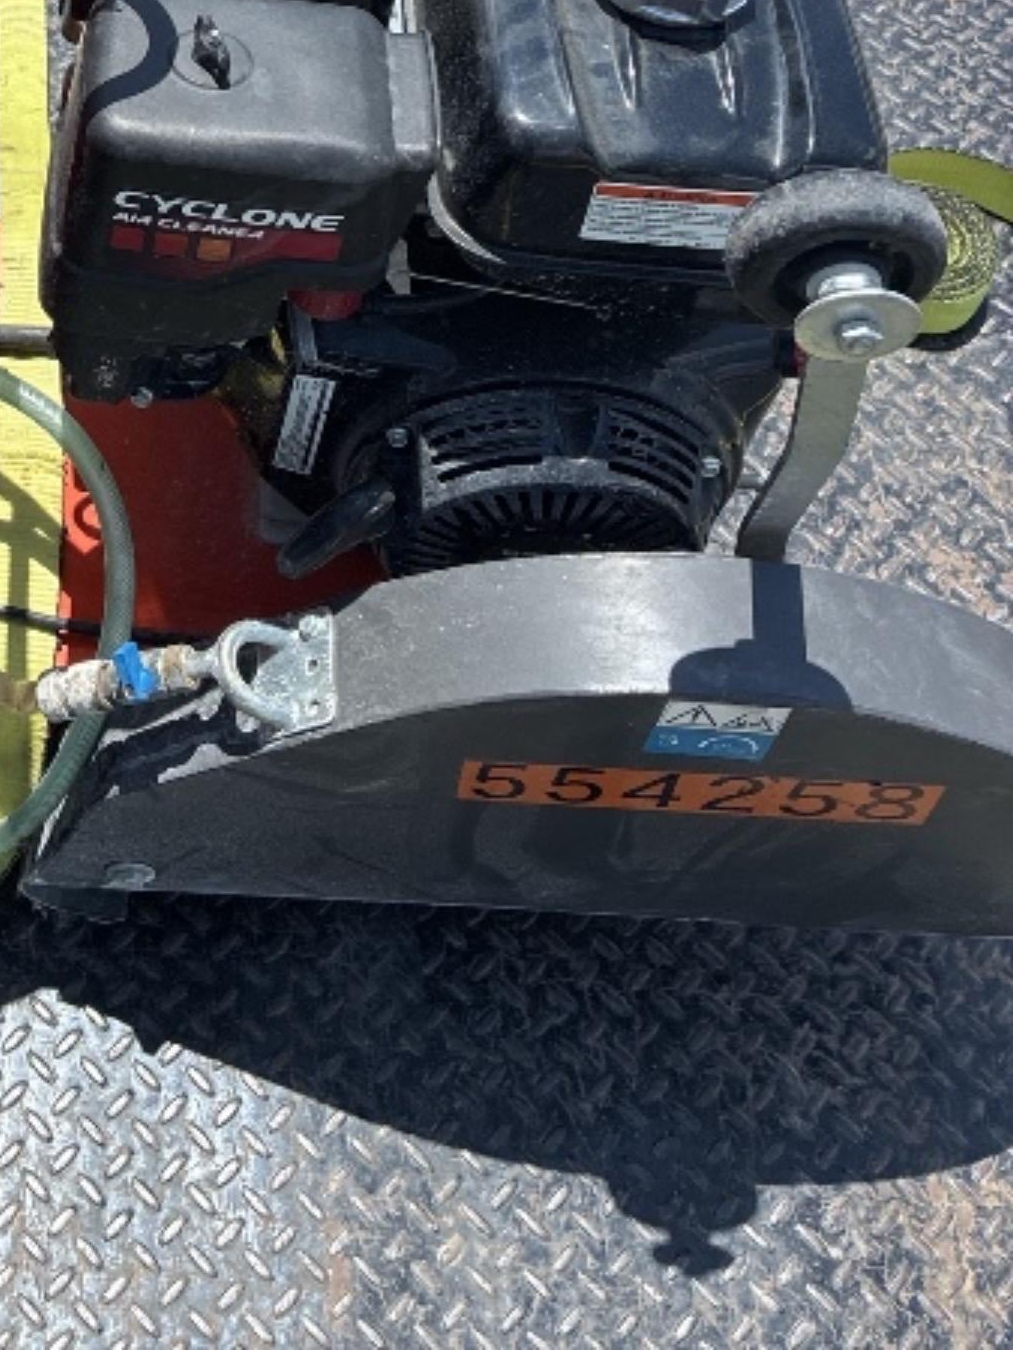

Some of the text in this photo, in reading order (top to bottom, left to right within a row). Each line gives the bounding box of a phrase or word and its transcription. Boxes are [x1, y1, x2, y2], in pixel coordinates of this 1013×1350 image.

[112, 211, 265, 240] AIR CLEANER
[113, 190, 345, 233] CYCLONE
[472, 763, 925, 820] 554258
